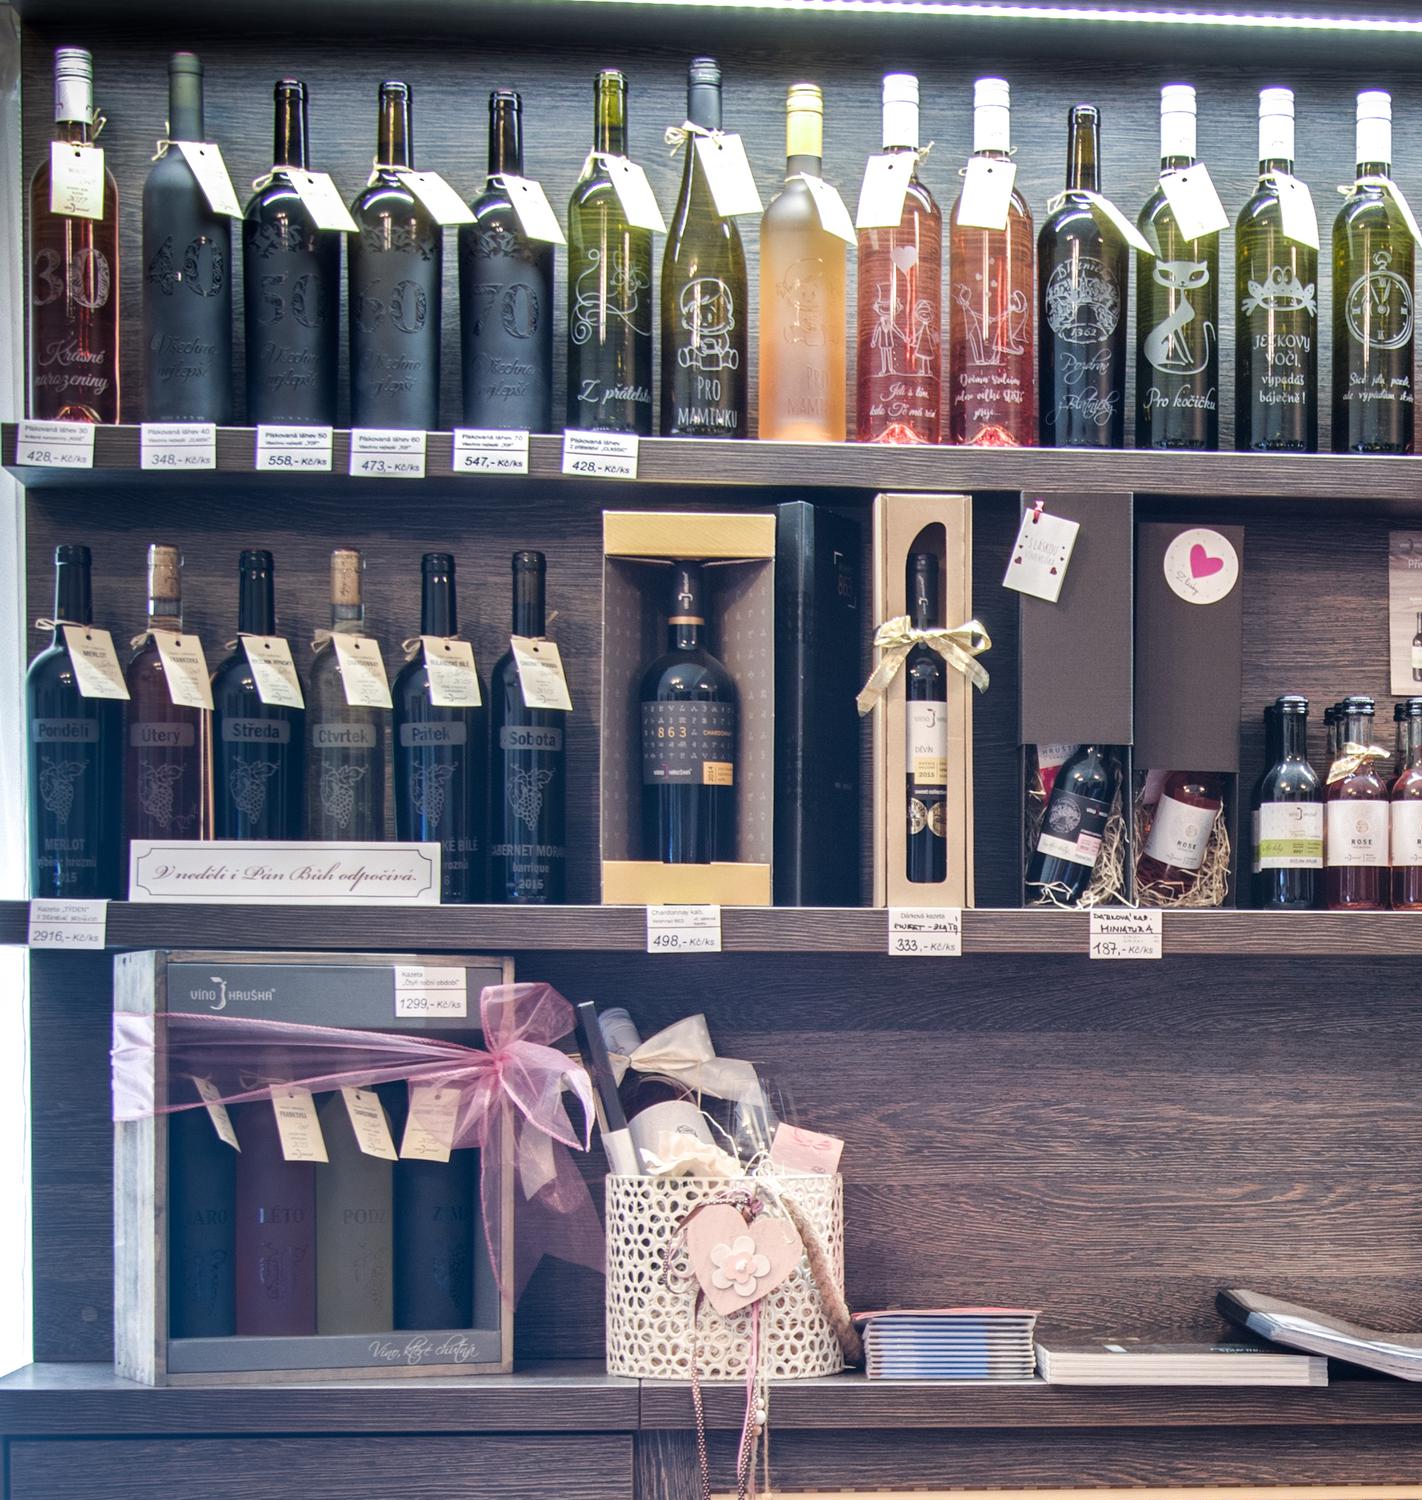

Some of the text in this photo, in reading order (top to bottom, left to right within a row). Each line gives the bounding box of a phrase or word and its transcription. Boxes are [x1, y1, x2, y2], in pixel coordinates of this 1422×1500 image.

[39, 339, 105, 367] Krásné
[36, 372, 109, 395] narozeniny
[697, 375, 721, 401] PRO
[577, 380, 602, 403] Z
[1143, 384, 1216, 411] Pro kočičku
[677, 407, 738, 428] MAMINKU
[28, 451, 87, 464] 428,- Kč/ks
[151, 454, 210, 466] 348,- Kč/ks
[268, 455, 328, 467] 558,- Kč/ks
[464, 456, 523, 468] 547,- Kč/ks
[361, 460, 420, 472] 473,- Kč/ks
[572, 459, 630, 473] 428,- Kč/ks
[39, 722, 90, 740] Pondělí
[141, 724, 182, 745] Úterý
[232, 722, 280, 740] Středa
[411, 726, 452, 742] Pátek
[657, 726, 688, 738] 863
[509, 730, 557, 748] Sobota
[45, 838, 86, 851] MERLOT
[151, 861, 417, 892] V neděli i Pán Bůh odpočívá.
[518, 879, 544, 890] 2015
[34, 930, 99, 943] 2916,- Kč/ks
[652, 934, 716, 948] 498,- Kč/ks
[930, 943, 957, 951] Kč/ks
[1128, 946, 1154, 955] Kč/ks
[228, 989, 273, 1002] HRUŠKA
[400, 998, 462, 1010] 1299,- Kč/ks
